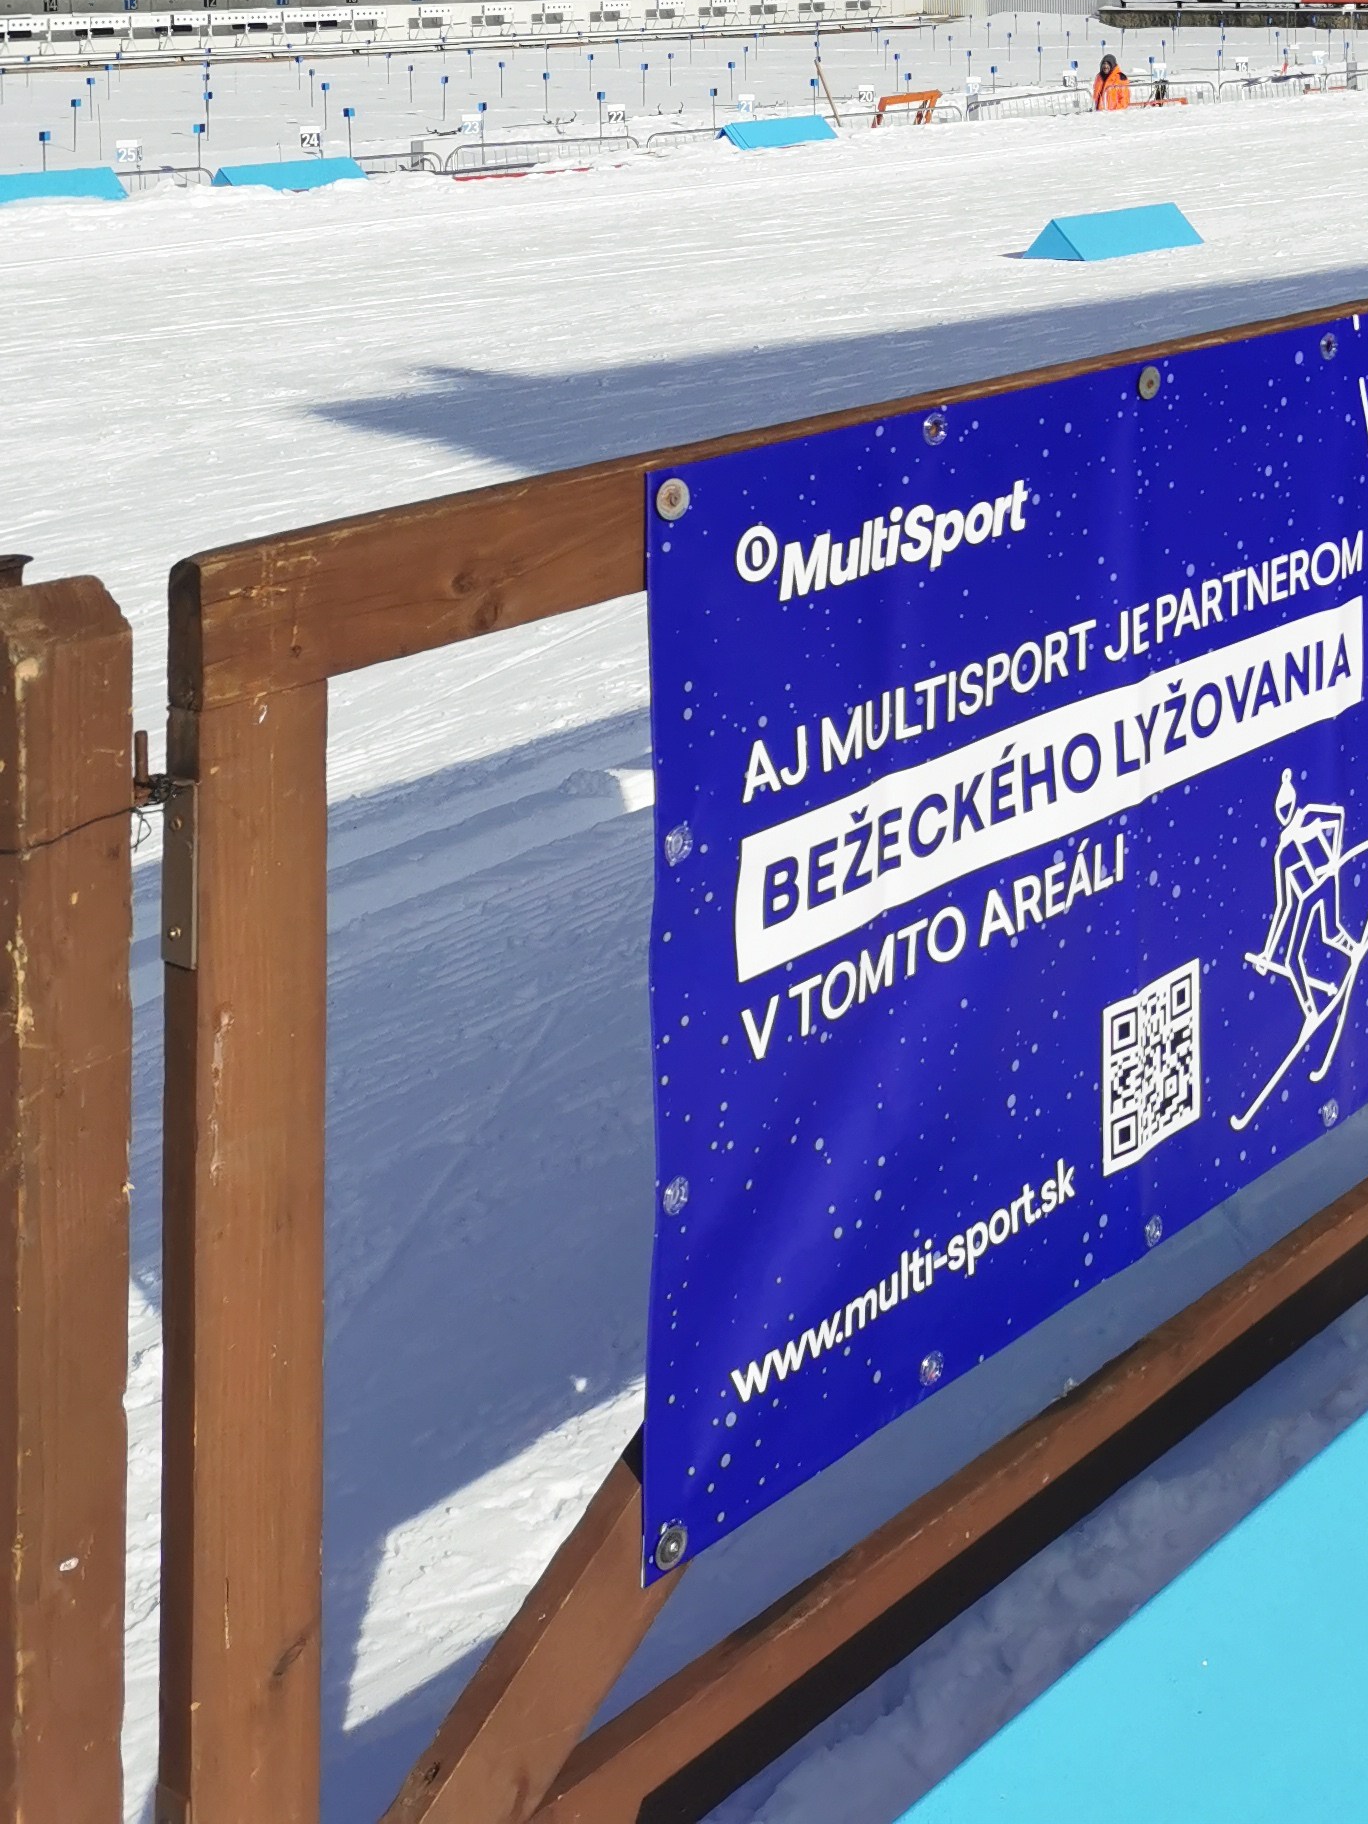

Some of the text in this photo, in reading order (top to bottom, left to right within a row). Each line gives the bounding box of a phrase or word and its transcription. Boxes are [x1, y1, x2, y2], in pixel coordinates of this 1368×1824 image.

[1236, 62, 1247, 72] 16
[860, 91, 873, 103] 20
[740, 101, 753, 113] 21
[609, 111, 624, 124] 22
[464, 121, 480, 134] 23
[301, 133, 319, 148] 24
[118, 147, 136, 163] 25
[779, 479, 1028, 602] MultiSport
[742, 529, 1363, 804] AJ MULTISPORT JE PARTNEROM
[762, 632, 1352, 930] BEŽECKÉHO LYŽOVANIA
[740, 833, 1125, 1061] V TOMTO AREÁLI
[730, 1157, 1076, 1403] www.multi-sport.sk
